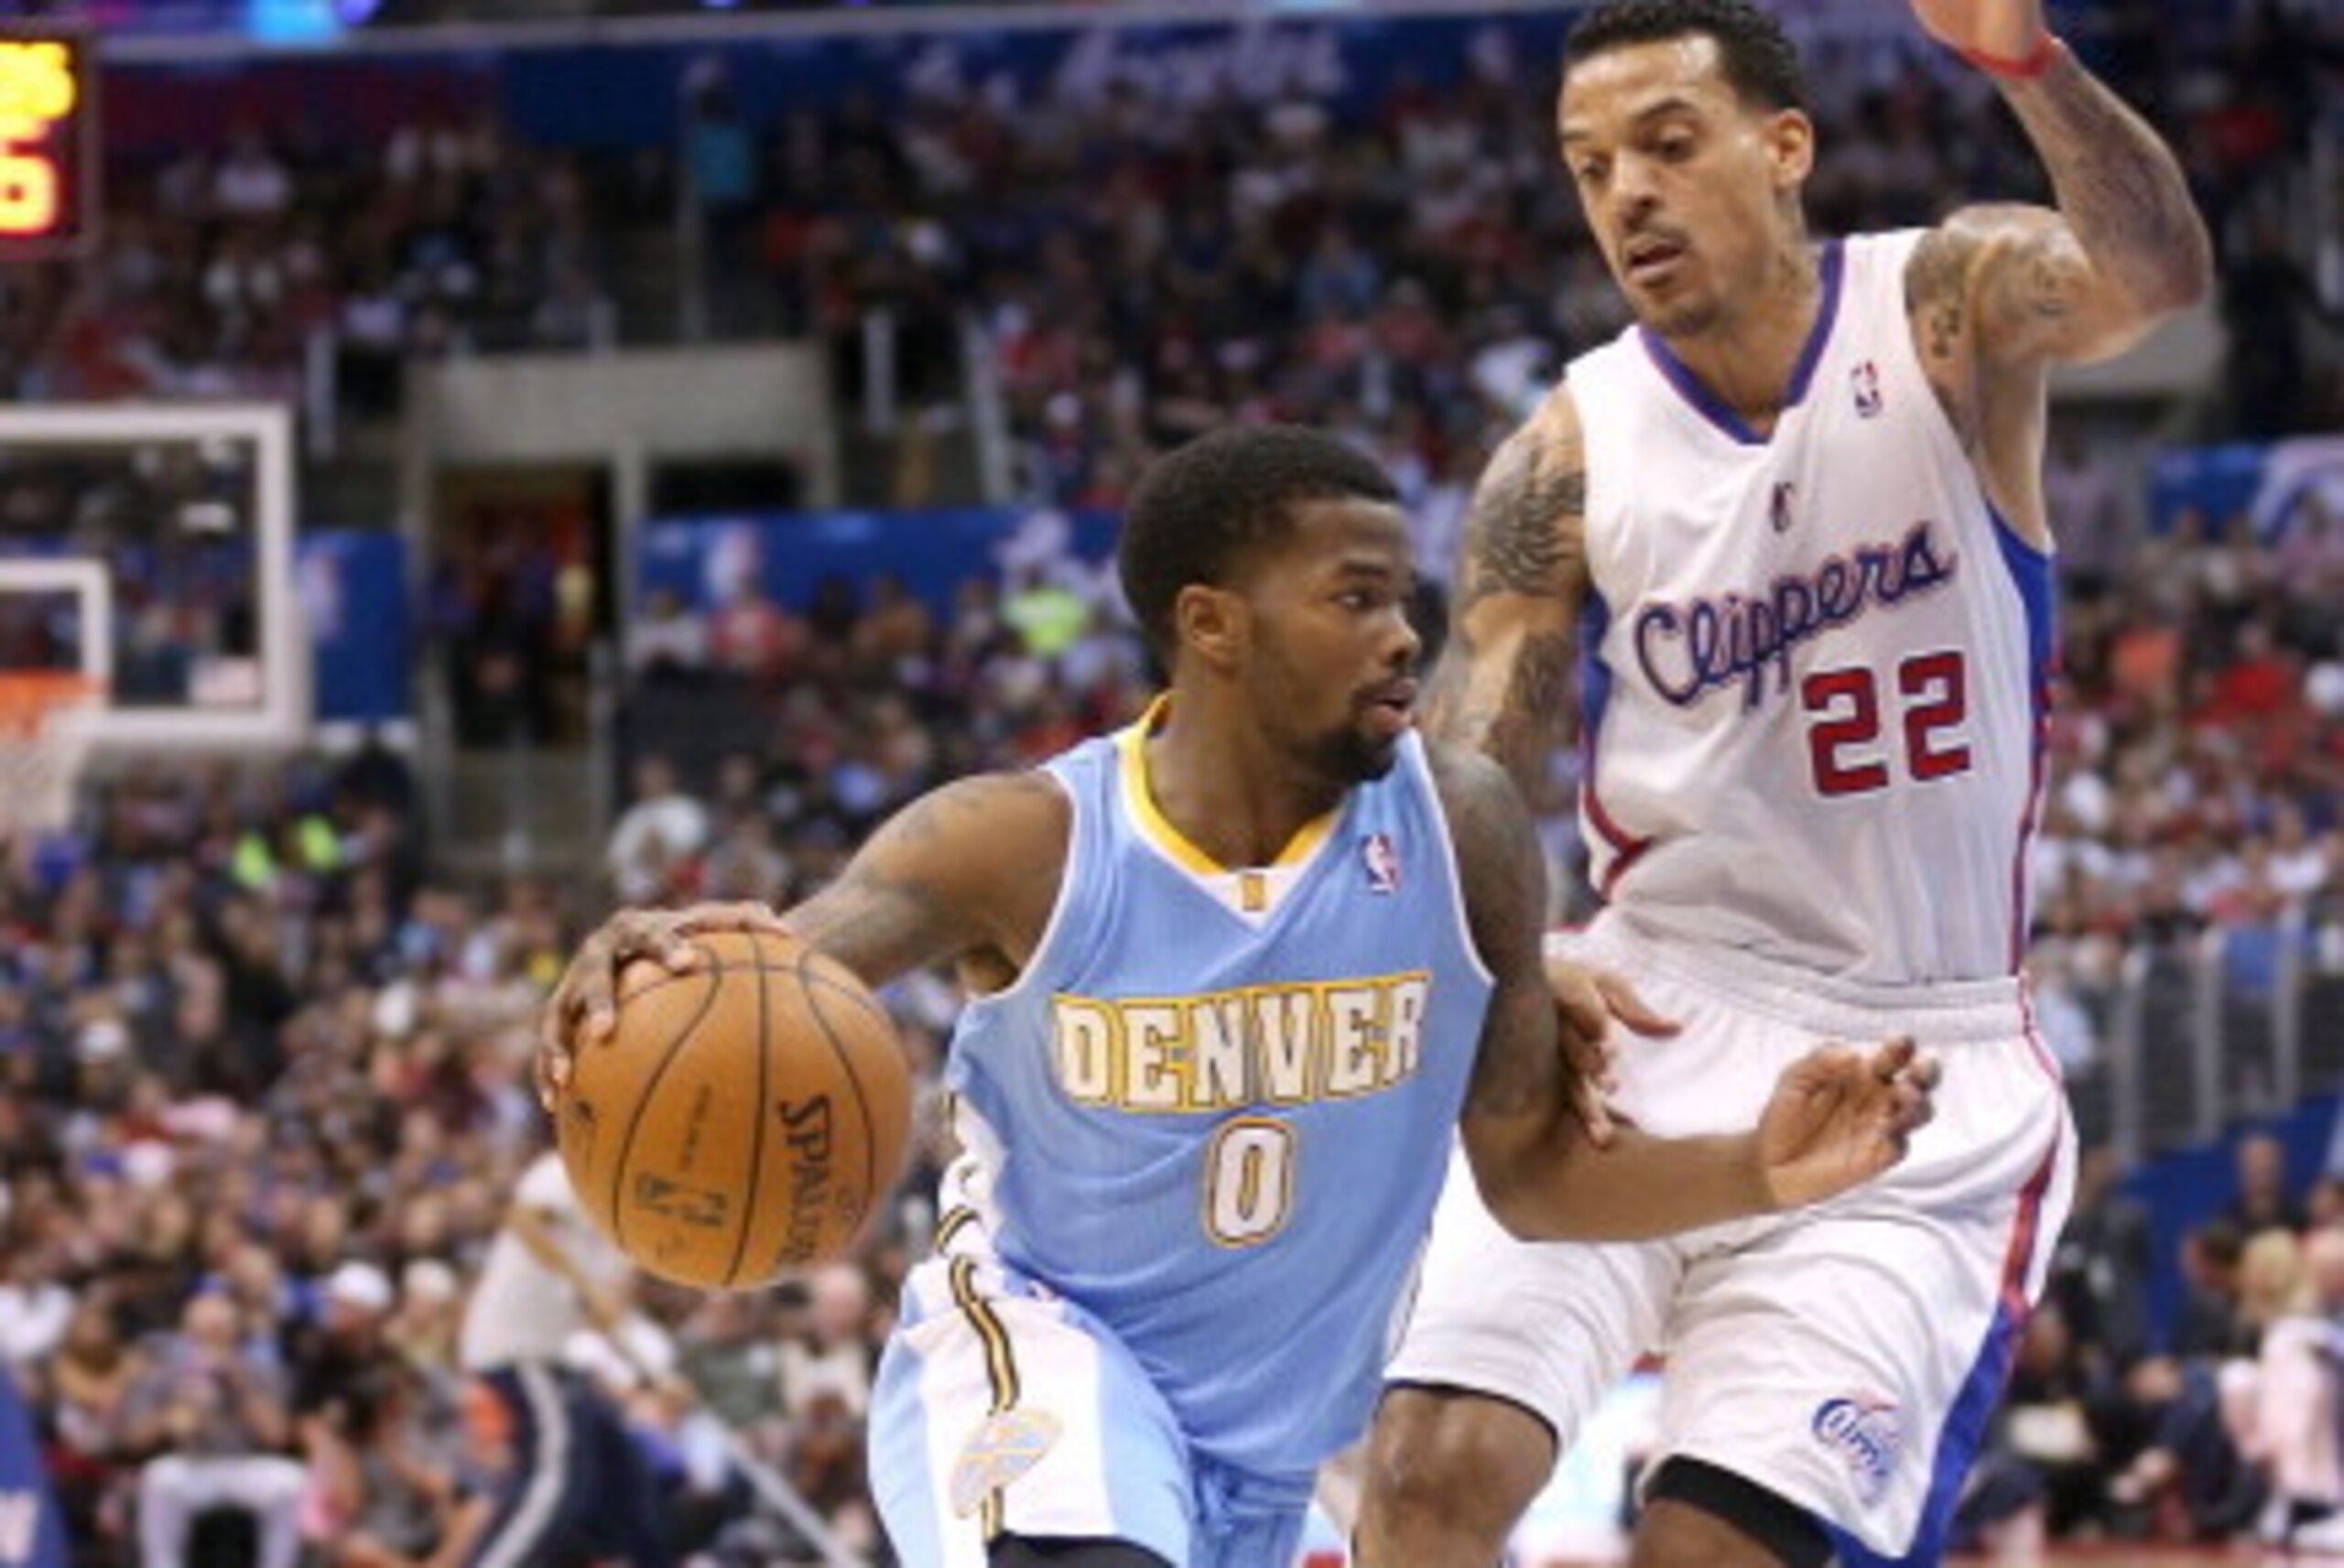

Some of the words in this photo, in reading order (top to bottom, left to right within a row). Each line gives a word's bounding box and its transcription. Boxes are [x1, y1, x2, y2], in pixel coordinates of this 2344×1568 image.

[1634, 521, 1958, 709] Clippers
[1801, 650, 1971, 796] 22
[1053, 974, 1429, 1110] DENVER
[1203, 1116, 1295, 1247] 0
